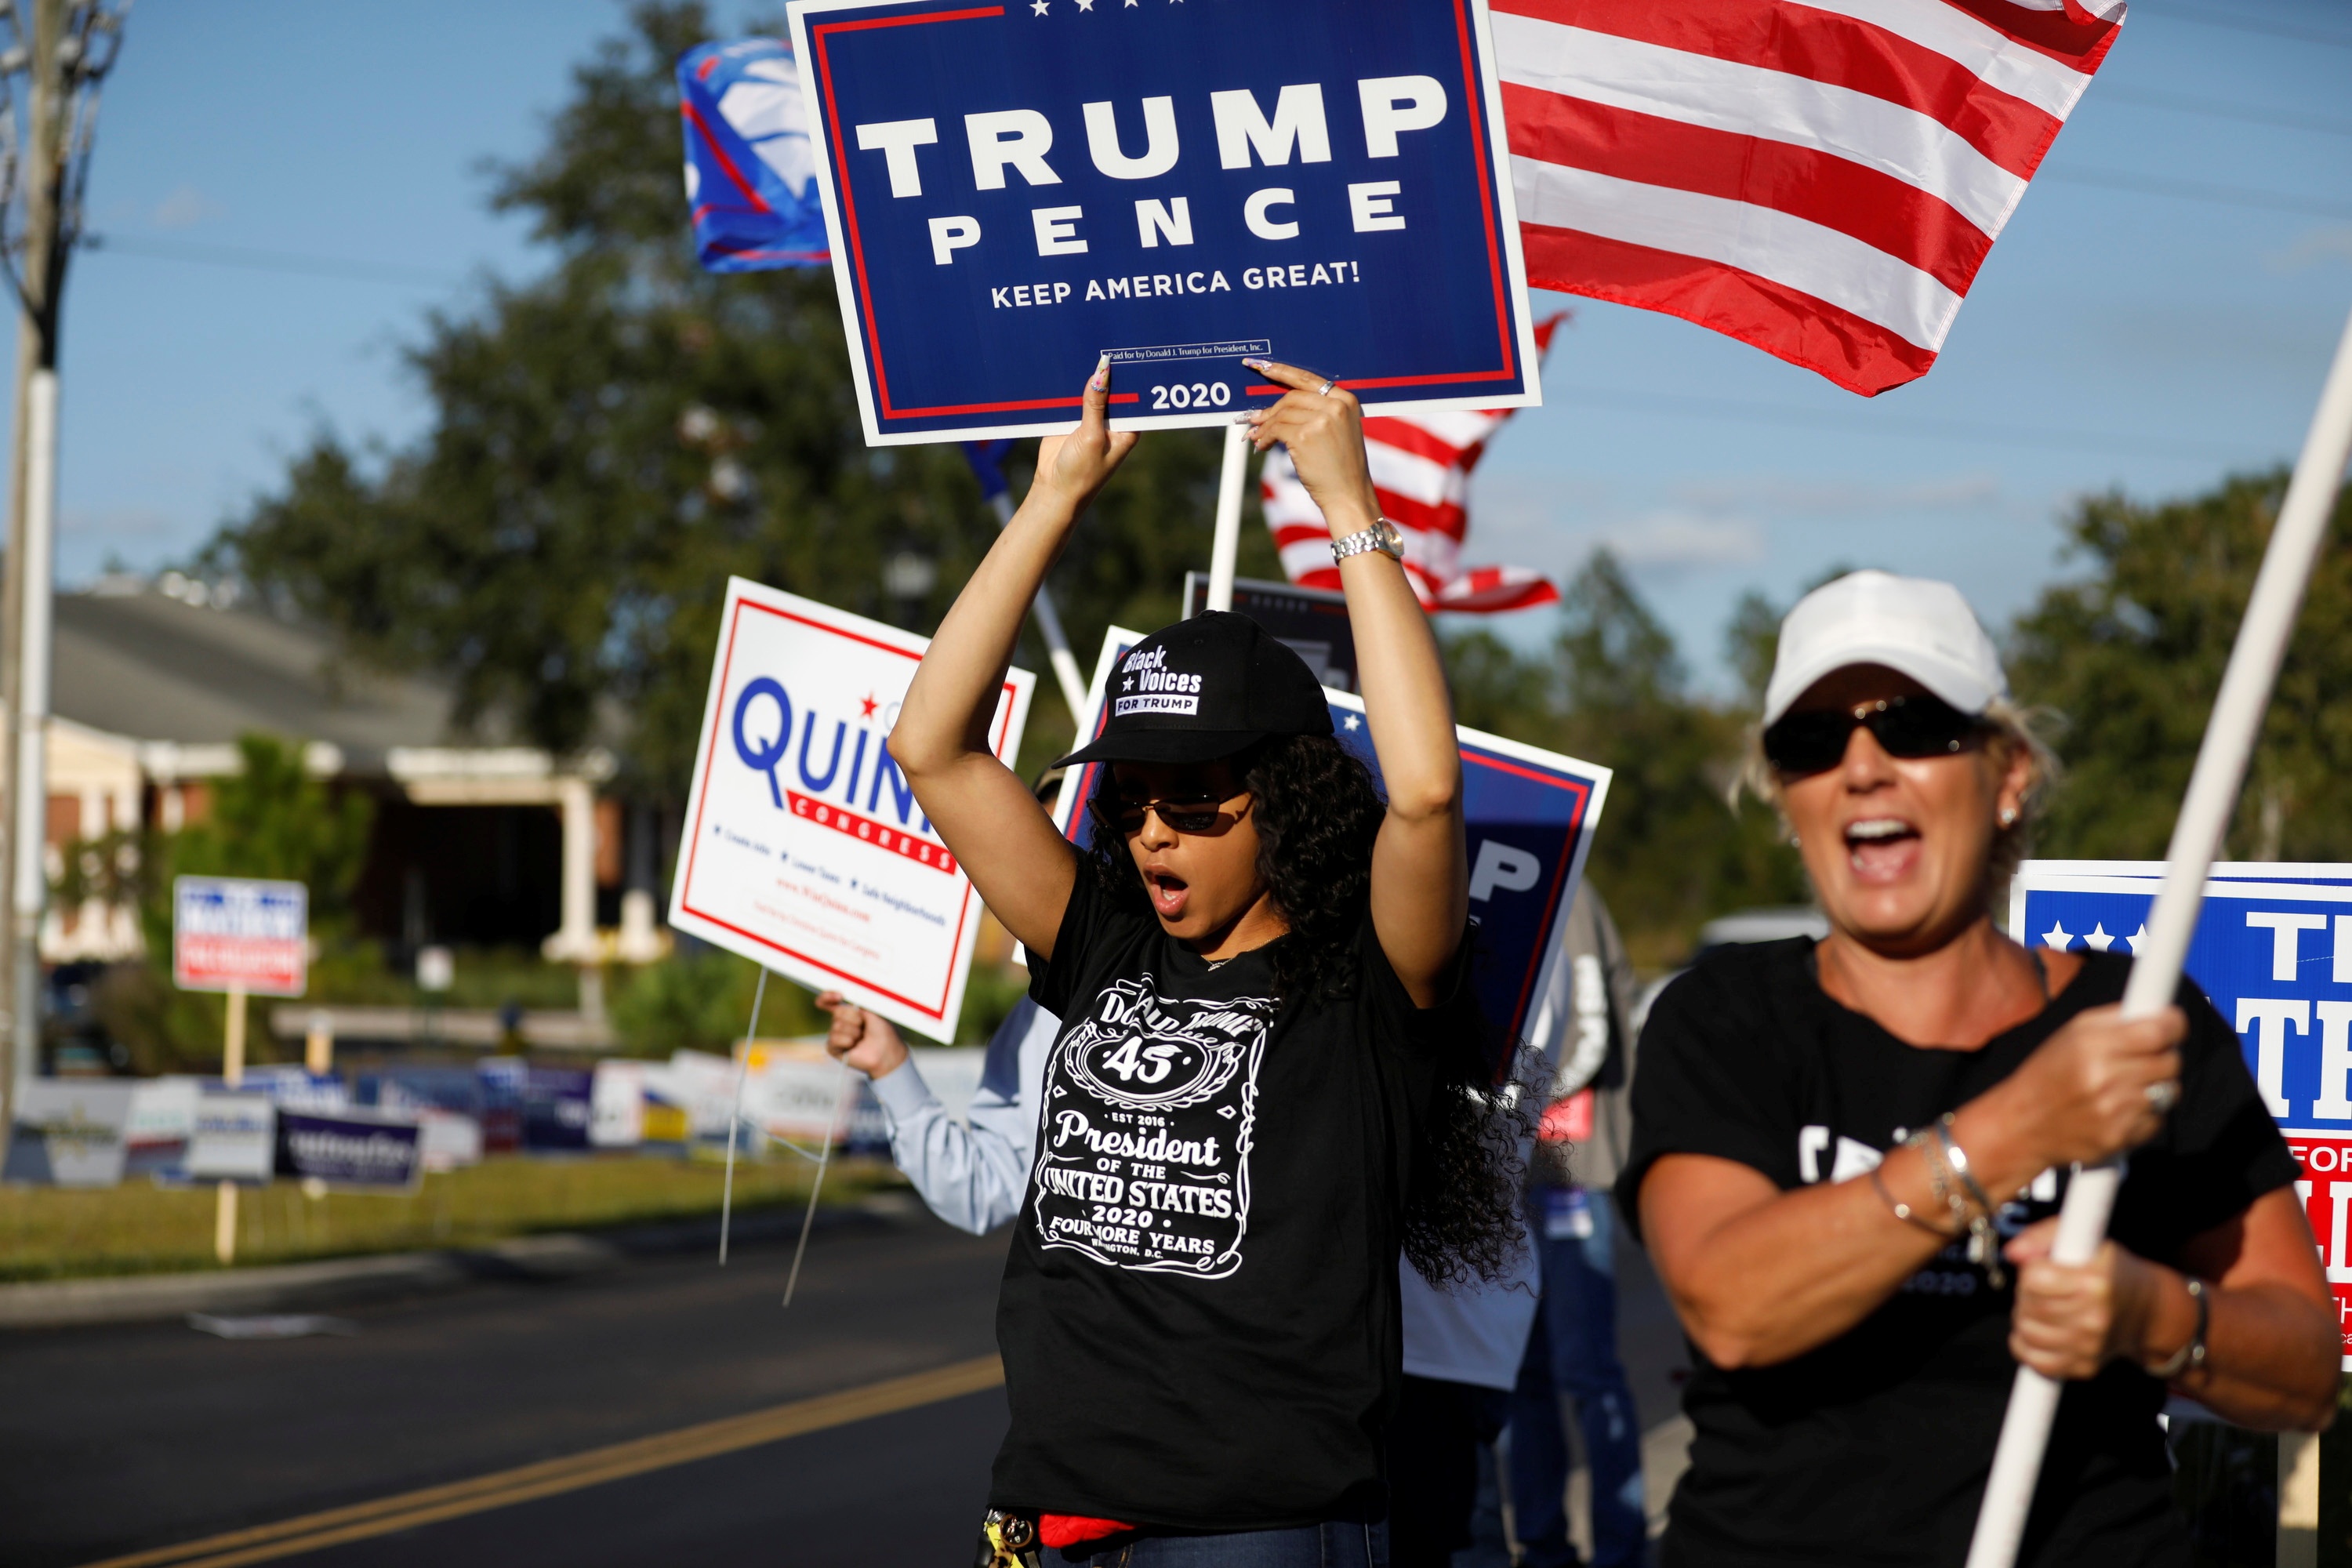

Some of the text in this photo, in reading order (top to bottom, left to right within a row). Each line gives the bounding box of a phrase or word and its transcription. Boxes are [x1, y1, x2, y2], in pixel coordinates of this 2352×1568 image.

[855, 74, 1448, 198] TRUMP
[928, 180, 1406, 266] PENCE
[991, 260, 1360, 309] KEEP AMERICA GREAT!
[1108, 342, 1263, 361] Paid for by Donald J. Trump for President, Inc.
[1151, 381, 1231, 410] 2020
[1122, 644, 1167, 673] Black
[1139, 665, 1202, 693] Voices
[1117, 698, 1193, 712] FOR TRUMP
[732, 676, 931, 833] QUIN
[795, 797, 950, 869] CONGRESS
[1102, 1036, 1183, 1083] 45
[1112, 1112, 1166, 1127] EST 2016
[1053, 1109, 1221, 1167] President
[1096, 1157, 1167, 1180] OF THE
[1044, 1167, 1232, 1219] UNITED STATES
[1091, 1204, 1154, 1229] 2020
[1049, 1215, 1094, 1236] FOUR
[1149, 1232, 1215, 1255] YEARS
[1091, 1237, 1164, 1259] WANGTON, D.C.
